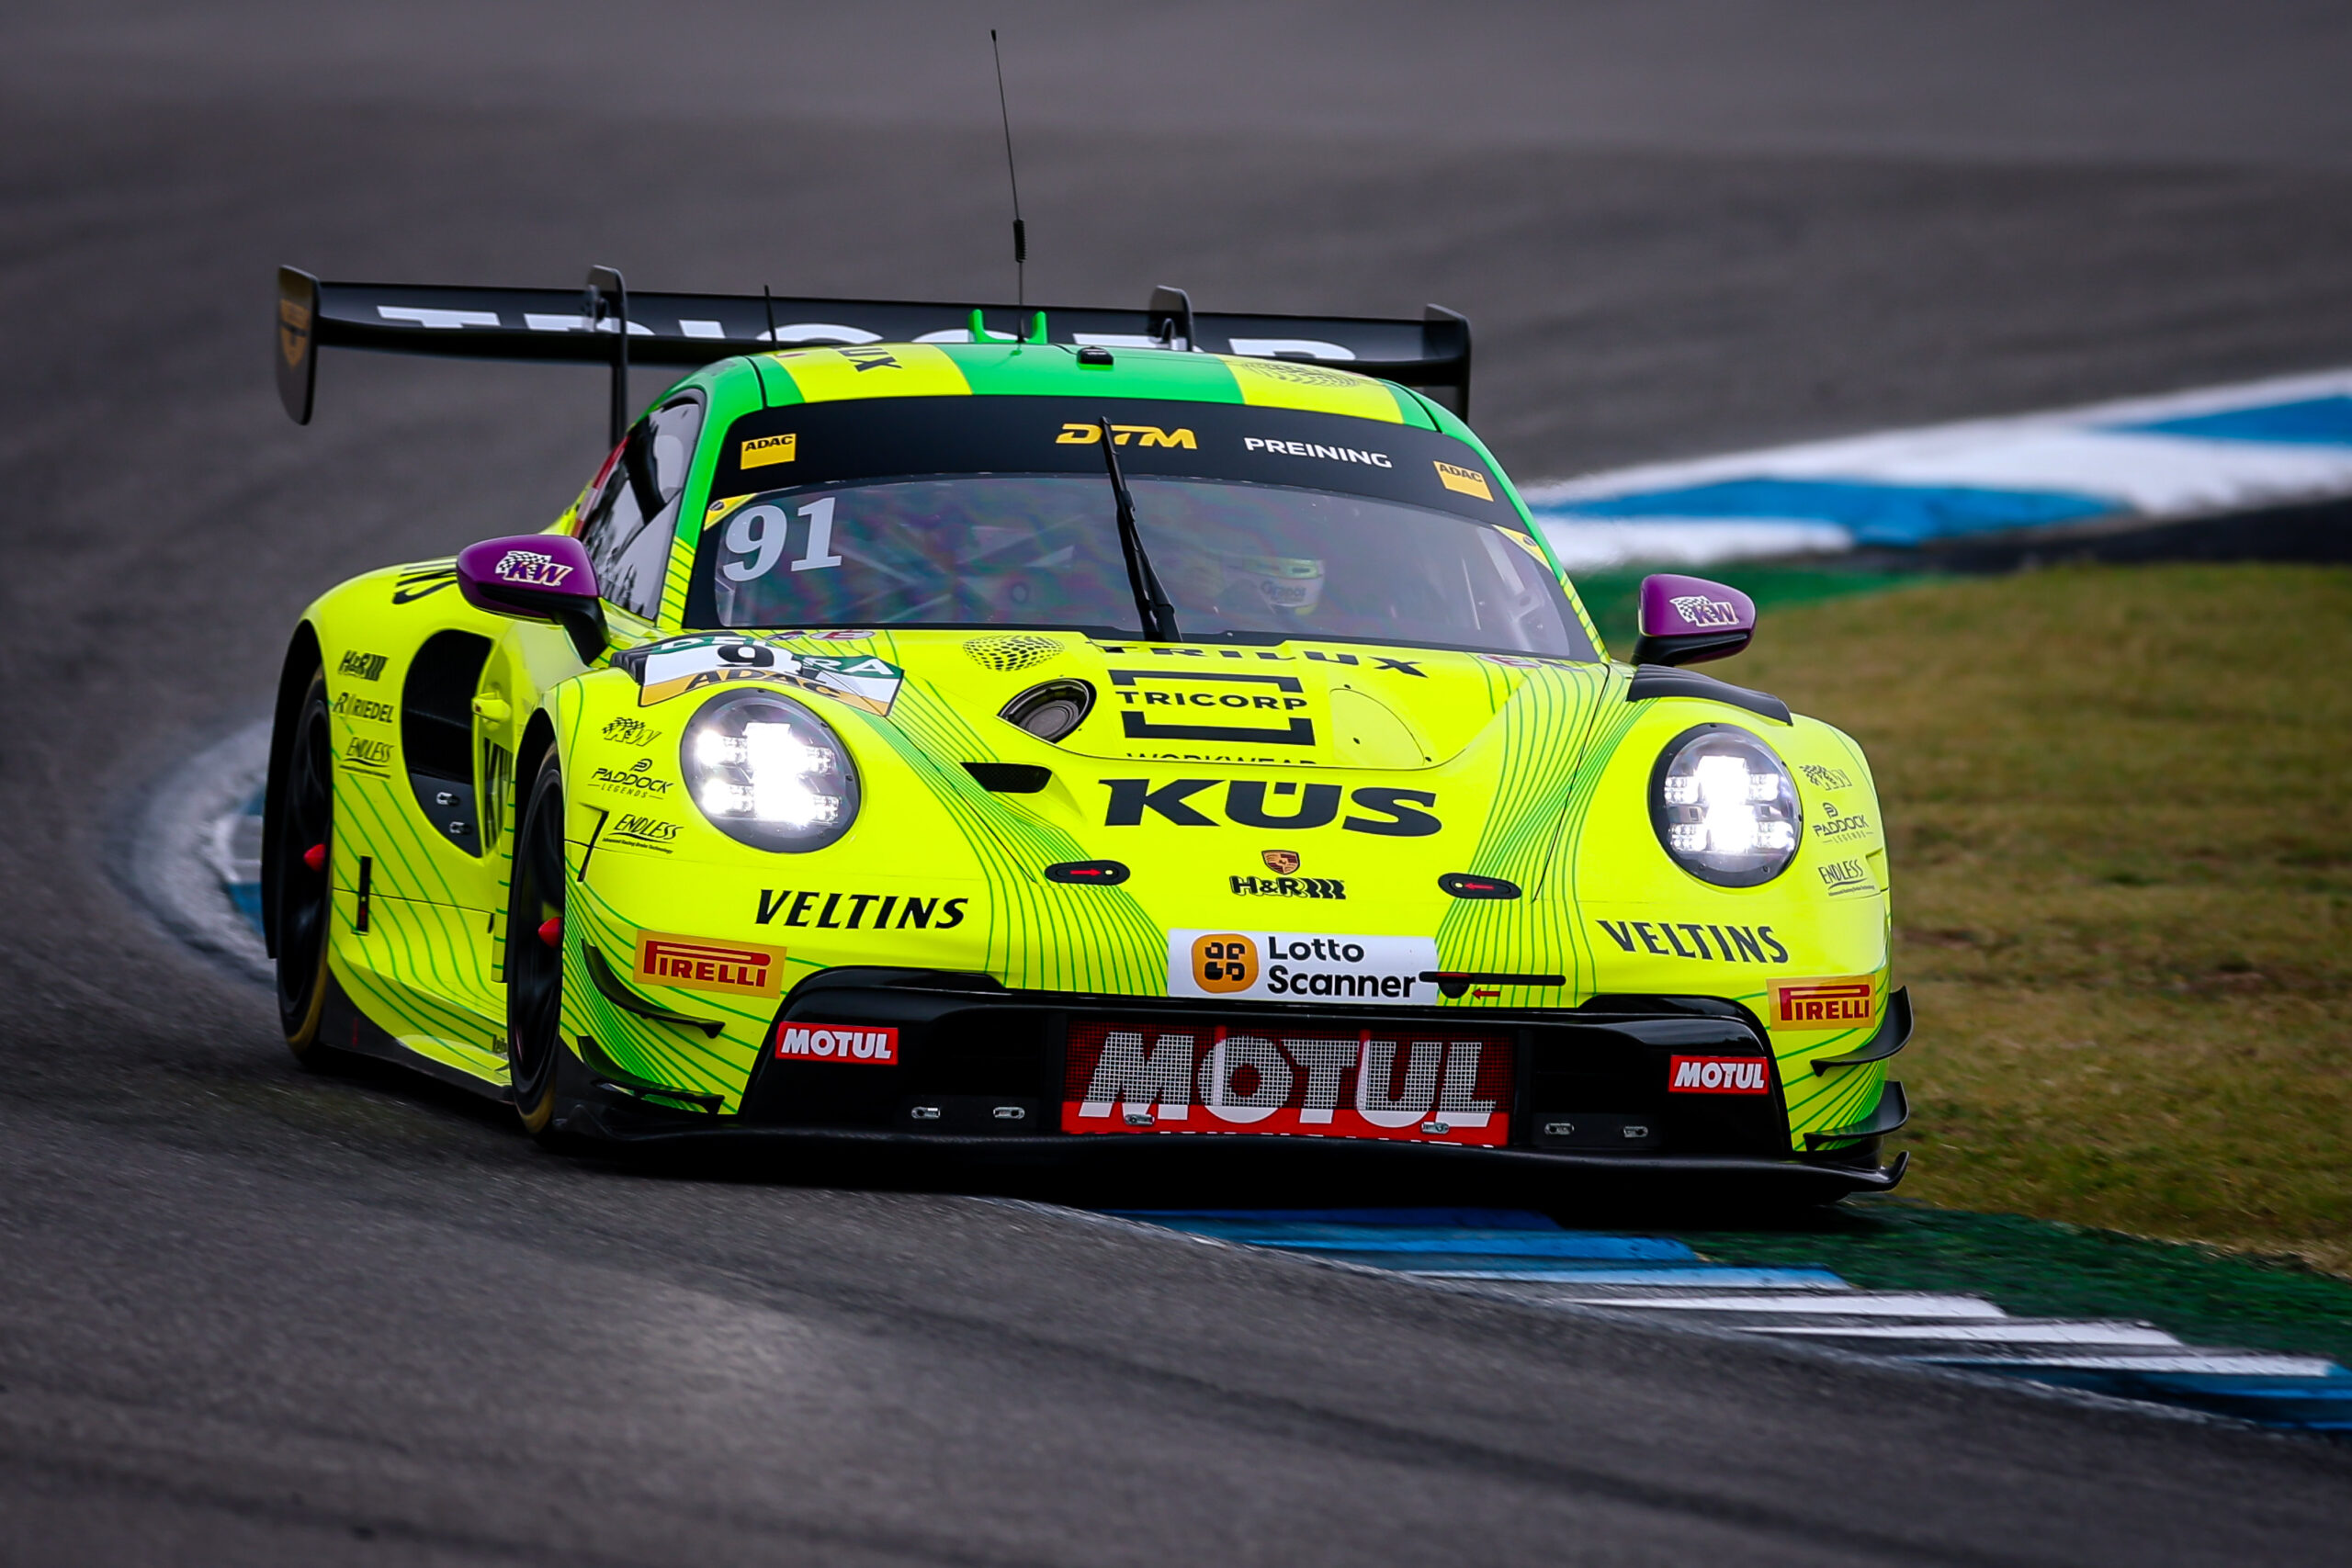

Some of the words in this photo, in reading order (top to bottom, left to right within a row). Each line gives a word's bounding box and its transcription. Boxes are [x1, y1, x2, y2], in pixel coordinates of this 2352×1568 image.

[744, 435, 794, 452] ADAC
[1056, 422, 1198, 450] DTM
[1245, 437, 1393, 468] PREINING
[1438, 463, 1483, 484] ADAC
[723, 498, 843, 582] 91
[503, 558, 574, 587] KW
[1690, 602, 1739, 626] KW
[1114, 691, 1308, 711] TRICORP
[345, 737, 396, 763] ENDLESS
[591, 768, 674, 795] PADDOCK
[601, 783, 649, 799] LEGENDS
[1097, 779, 1442, 837] KÜS
[613, 814, 684, 840] ENDLESS
[1812, 815, 1870, 838] PADDOCK
[1818, 859, 1864, 885] ENDLESS
[754, 888, 969, 930] VELTINS
[1269, 935, 1364, 964] Lotto
[1596, 919, 1790, 964] VELTINS
[643, 939, 772, 987] PIRELLI
[1267, 965, 1418, 998] Scanner
[1779, 983, 1871, 1021] PIRELLI
[780, 1028, 893, 1060] MOTUL
[1079, 1031, 1497, 1128] MOTUL
[1674, 1061, 1765, 1089] MOTUL
